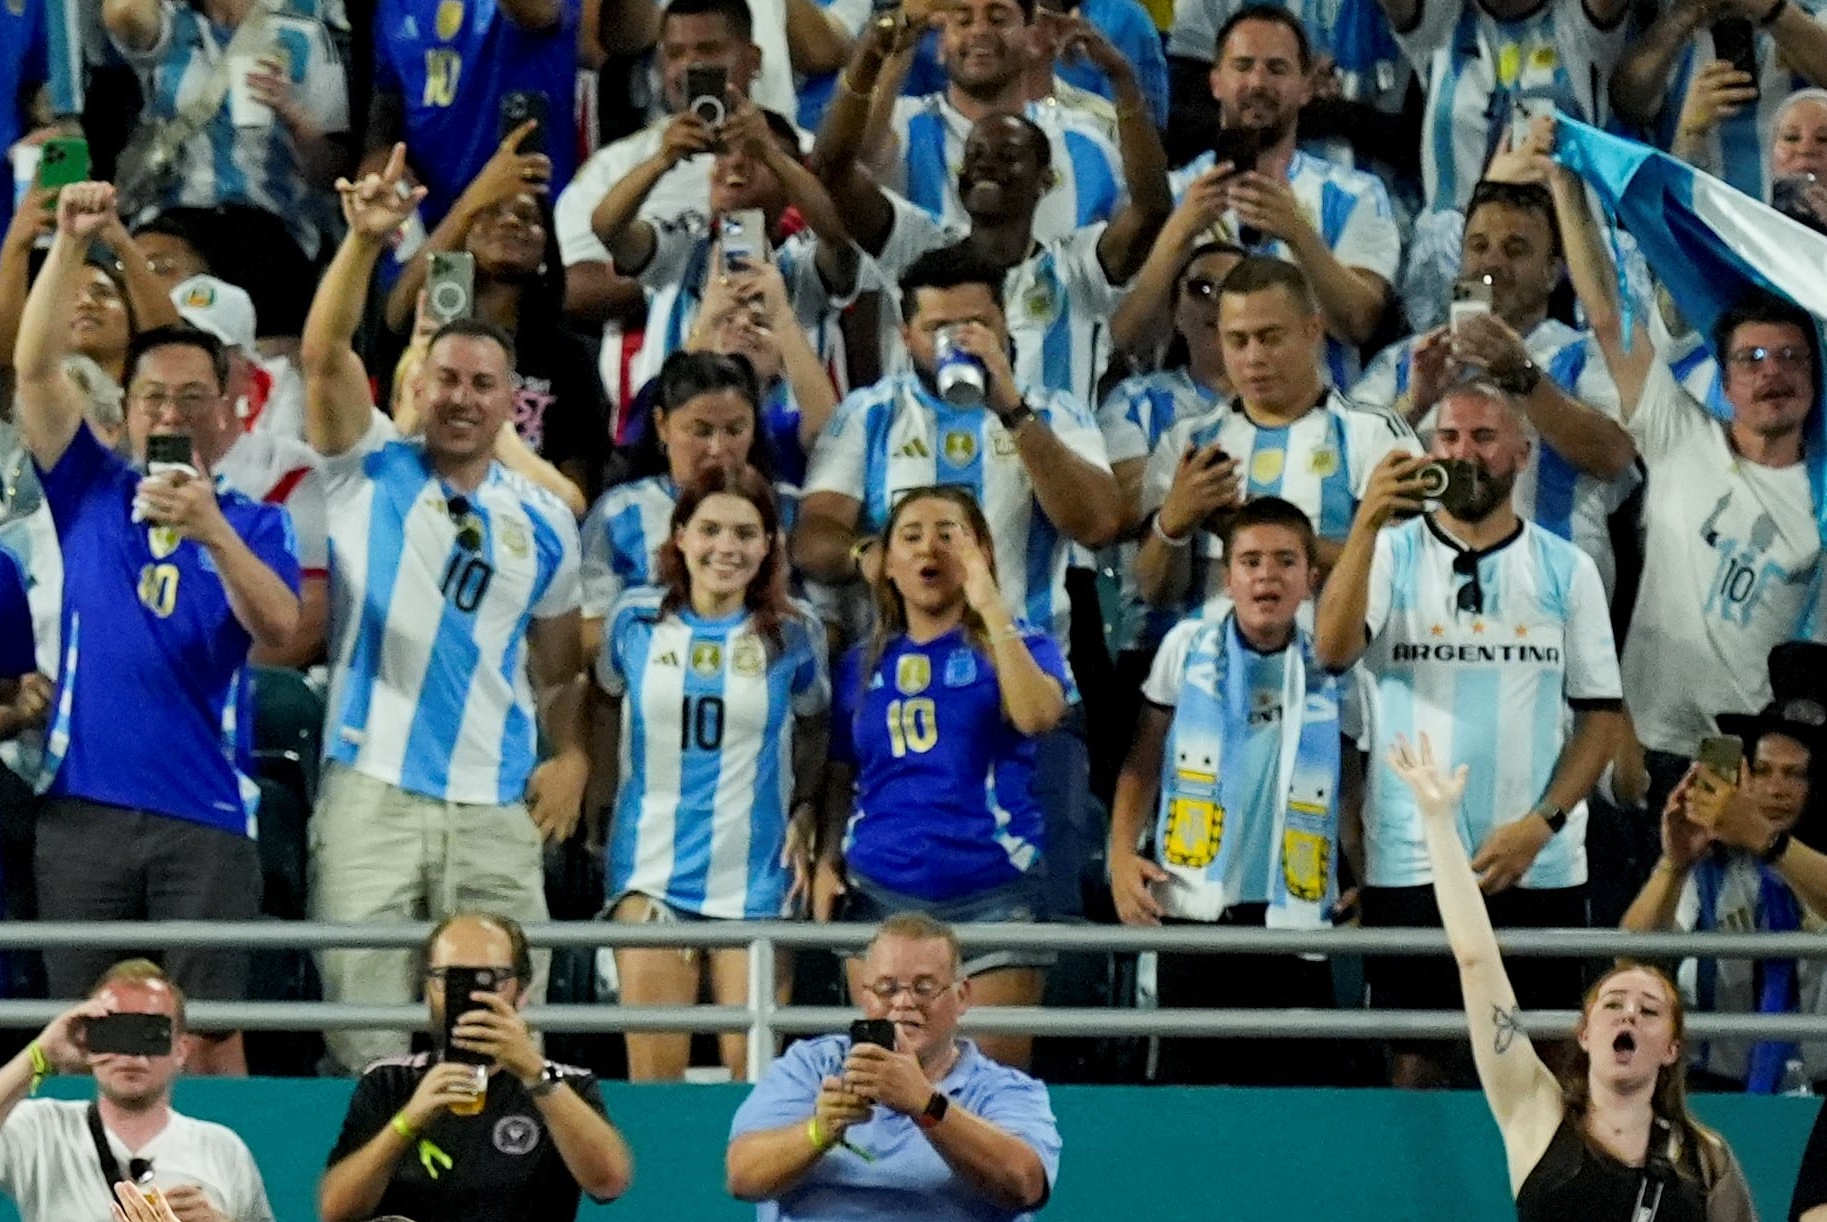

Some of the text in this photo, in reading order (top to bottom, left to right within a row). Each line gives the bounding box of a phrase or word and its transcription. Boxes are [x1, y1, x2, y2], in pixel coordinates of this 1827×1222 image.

[423, 49, 461, 108] 10
[439, 552, 493, 612] 10
[1717, 555, 1756, 604] 10
[1392, 642, 1560, 664] ARGENTINA
[680, 695, 725, 752] 10
[885, 697, 938, 759] 10
